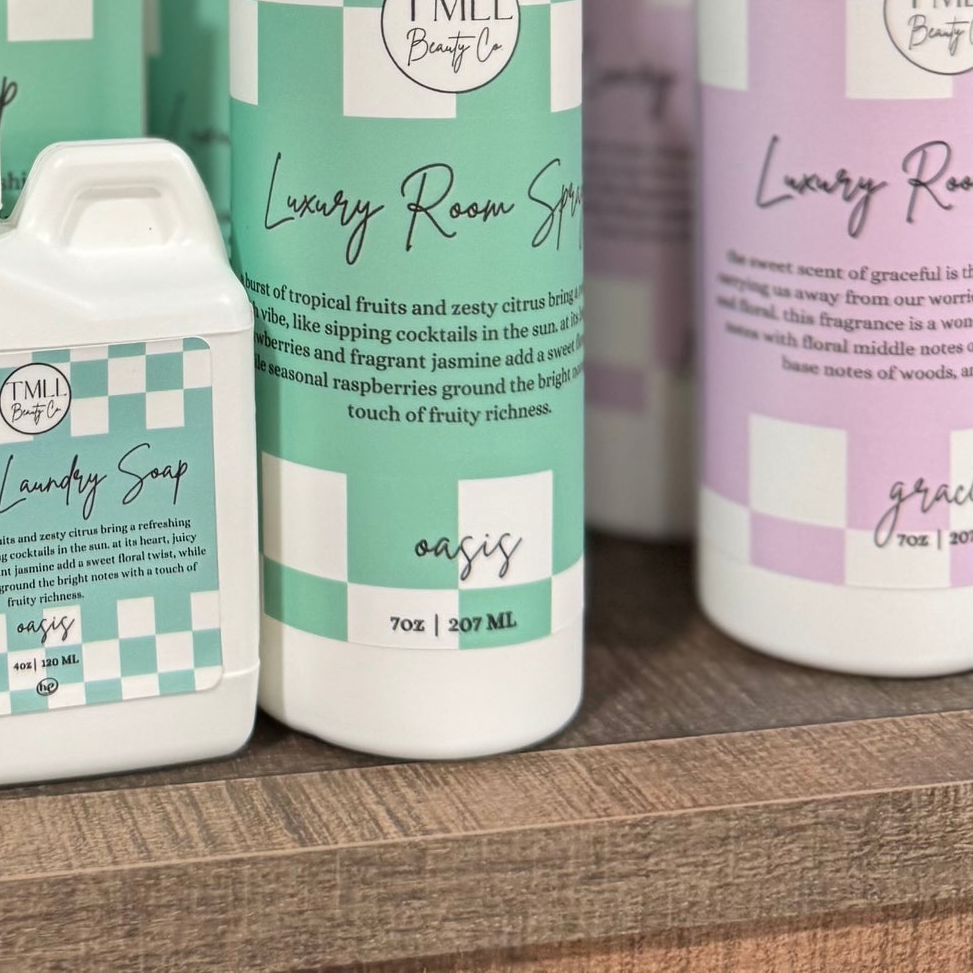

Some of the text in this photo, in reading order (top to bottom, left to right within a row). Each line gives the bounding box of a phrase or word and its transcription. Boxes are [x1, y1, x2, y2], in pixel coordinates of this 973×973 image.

[406, 27, 476, 74] Beauty
[907, 14, 970, 57] Beauty
[755, 134, 889, 239] Luxury
[902, 140, 972, 225] Roo
[264, 151, 385, 265] Luxury
[400, 162, 516, 252] Room
[245, 275, 270, 296] burst
[273, 284, 287, 300] of
[289, 287, 351, 311] tropical
[356, 296, 407, 314] fruits
[412, 300, 447, 315] and
[451, 300, 498, 317] zesty
[502, 295, 545, 312] citrus
[548, 289, 574, 307] bring
[260, 308, 289, 329] vibe,
[293, 313, 320, 332] like
[325, 319, 392, 344] sipping
[396, 326, 478, 342] cocktails
[482, 325, 499, 340] in
[503, 322, 529, 339] the
[532, 321, 558, 335] sun.
[314, 346, 346, 362] and
[350, 348, 426, 371] fragrant
[431, 352, 502, 373] jasmine
[505, 346, 534, 365] add
[547, 340, 575, 359] sweet
[5, 378, 68, 401] TMLL
[268, 366, 328, 386] seasonal
[333, 376, 437, 396] raspberries
[442, 378, 506, 400] ground
[510, 375, 535, 392] the
[538, 366, 570, 389] bright
[11, 400, 45, 425] Beauty
[347, 403, 552, 425] touch of fruity richness.
[118, 442, 189, 505] Soap
[10, 545, 55, 560] cocktails
[70, 541, 87, 553] the
[89, 541, 110, 551] sun.
[140, 534, 169, 546] heart,
[172, 531, 197, 546] juicy
[18, 531, 37, 543] and
[39, 529, 66, 542] zesty
[69, 526, 98, 538] citrus
[101, 522, 128, 535] bring
[138, 516, 191, 531] refreshing
[15, 561, 54, 578] jasmine
[57, 557, 76, 570] add
[86, 554, 115, 567] sweet
[119, 550, 145, 563] floral
[148, 548, 176, 560] twist,
[179, 544, 206, 557] while
[414, 531, 523, 581] oasis
[57, 572, 88, 586] bright
[91, 570, 119, 581] notes
[121, 565, 144, 578] with
[155, 561, 184, 574] touch
[8, 590, 84, 607] fruity richness.
[16, 615, 76, 643] oasis
[390, 610, 517, 635] 7oz 207 ML
[41, 653, 79, 670] 120 ML
